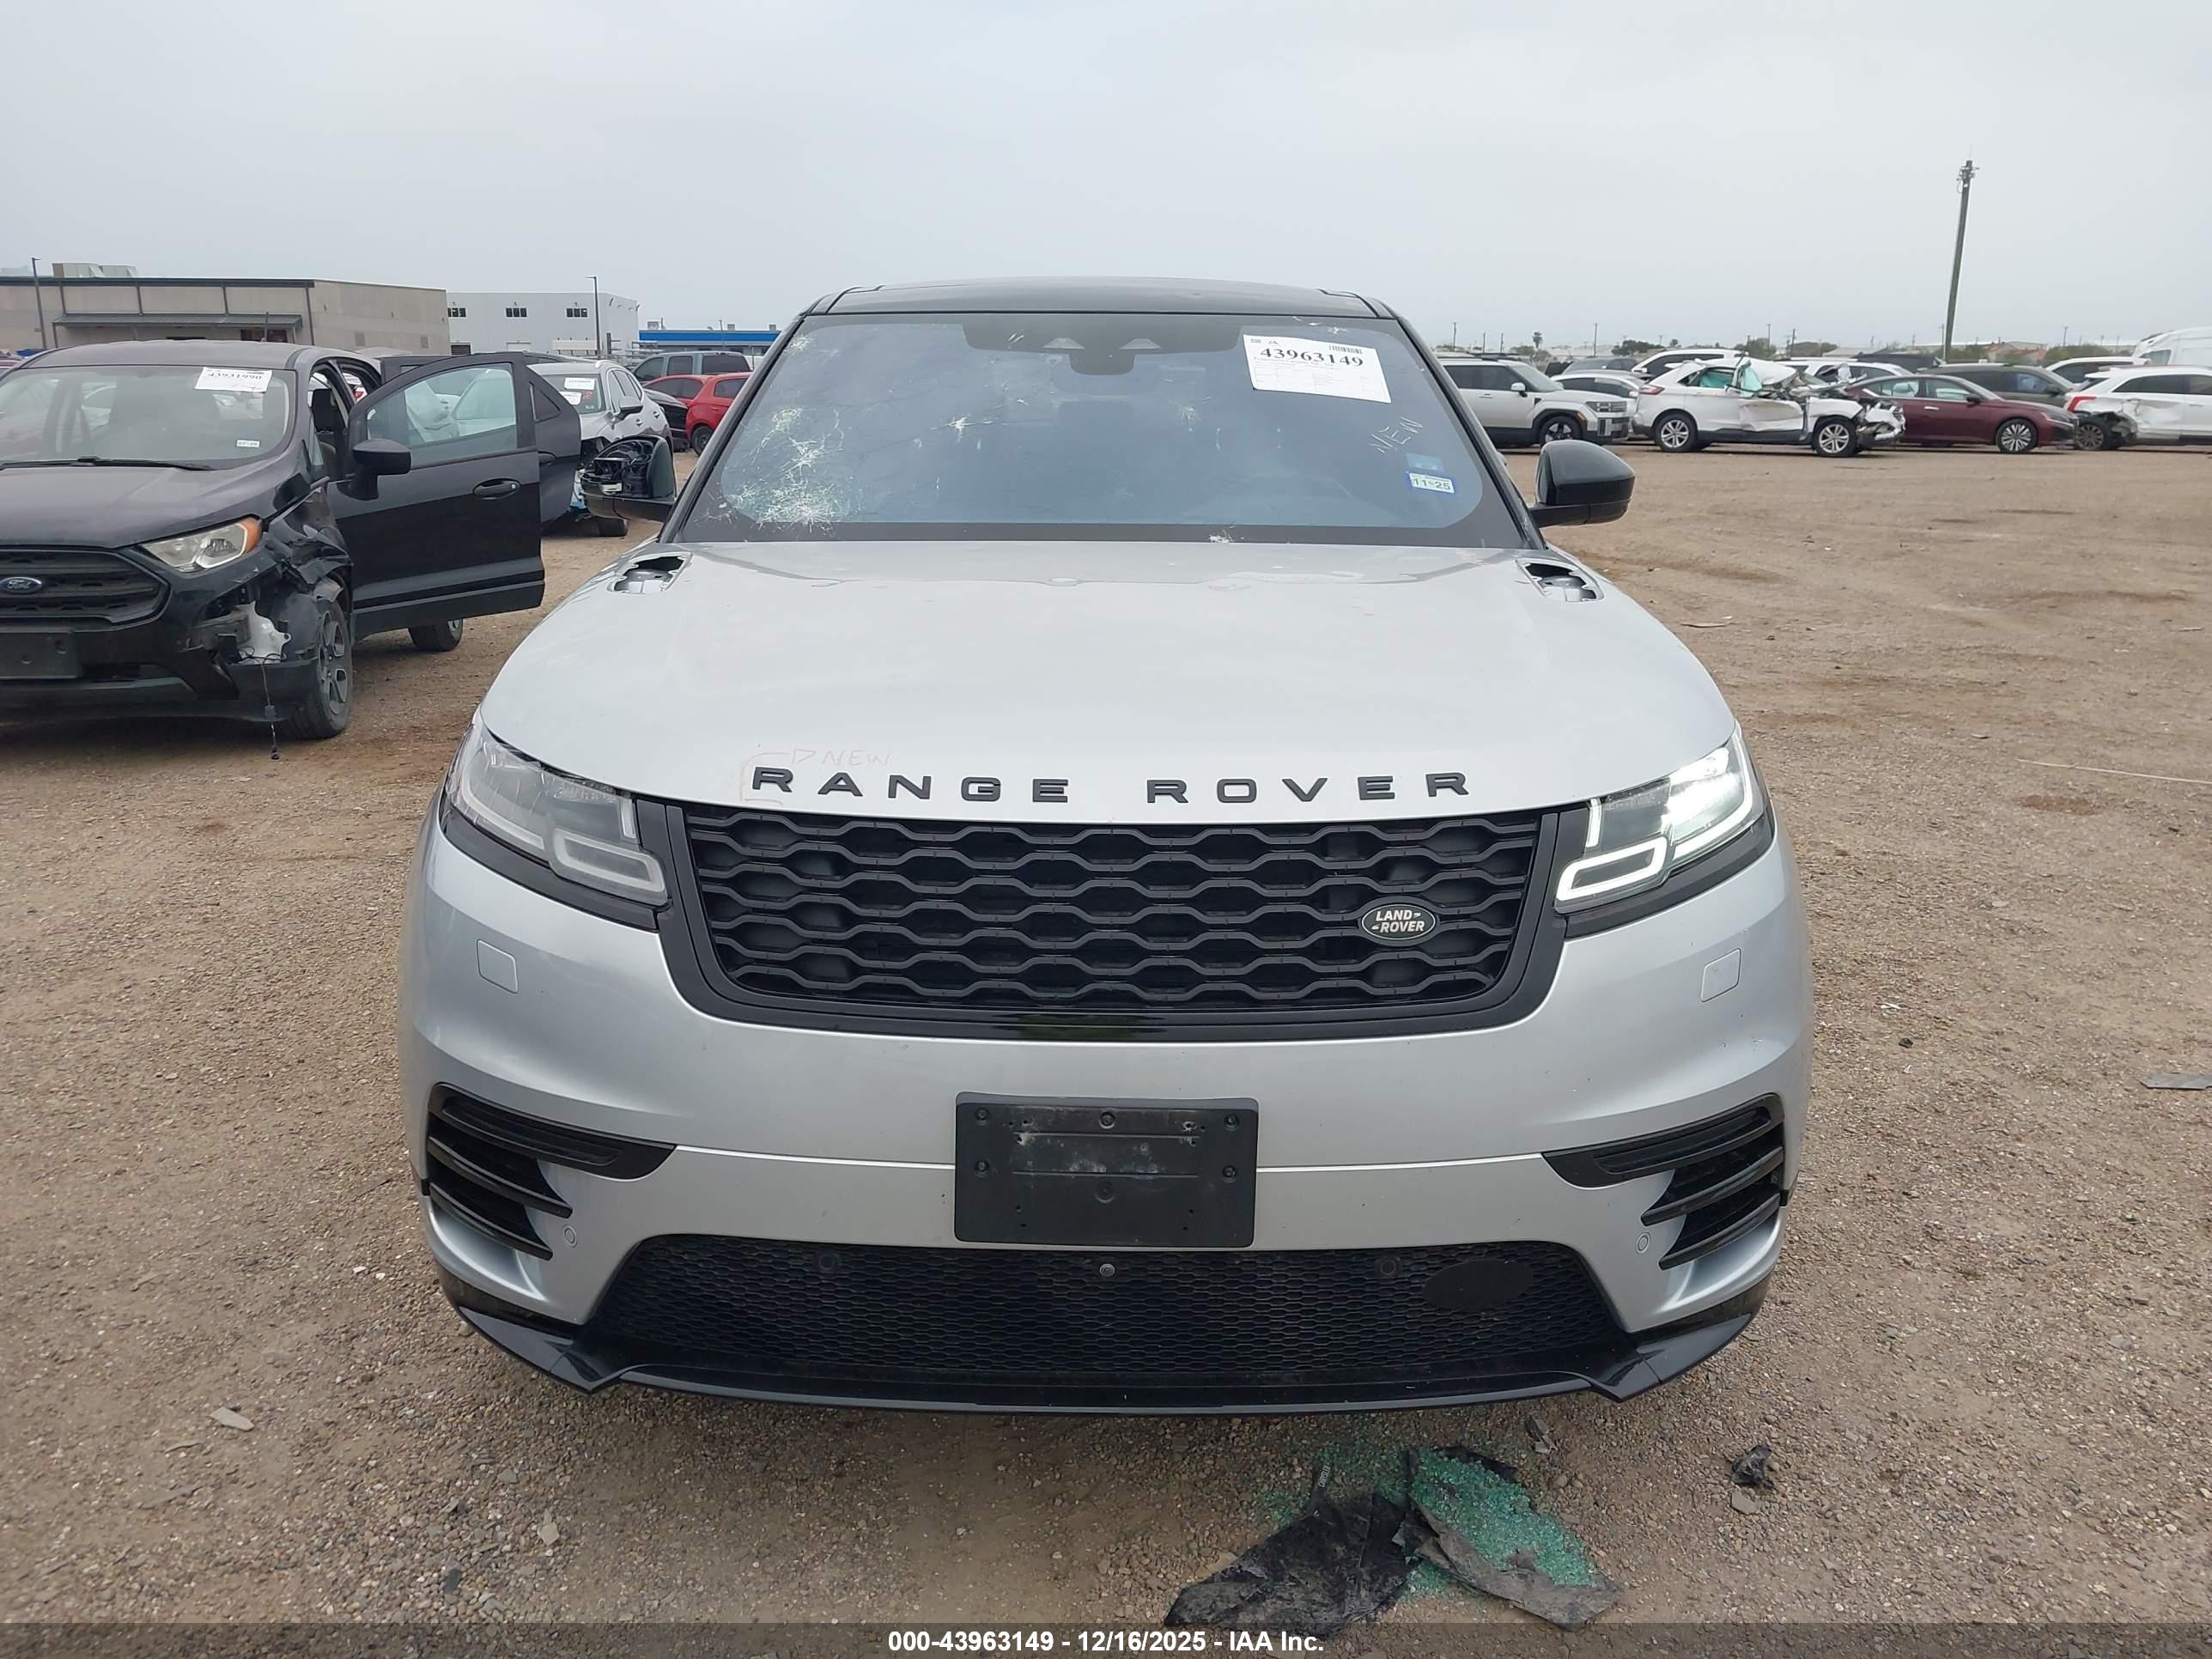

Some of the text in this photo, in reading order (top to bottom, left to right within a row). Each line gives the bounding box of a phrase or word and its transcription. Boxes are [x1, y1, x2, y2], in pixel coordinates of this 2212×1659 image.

[1260, 347, 1364, 367] 43963149
[751, 766, 1470, 804] RANGE ROVER
[1376, 910, 1413, 921] LAND
[1379, 921, 1425, 933] ROVER
